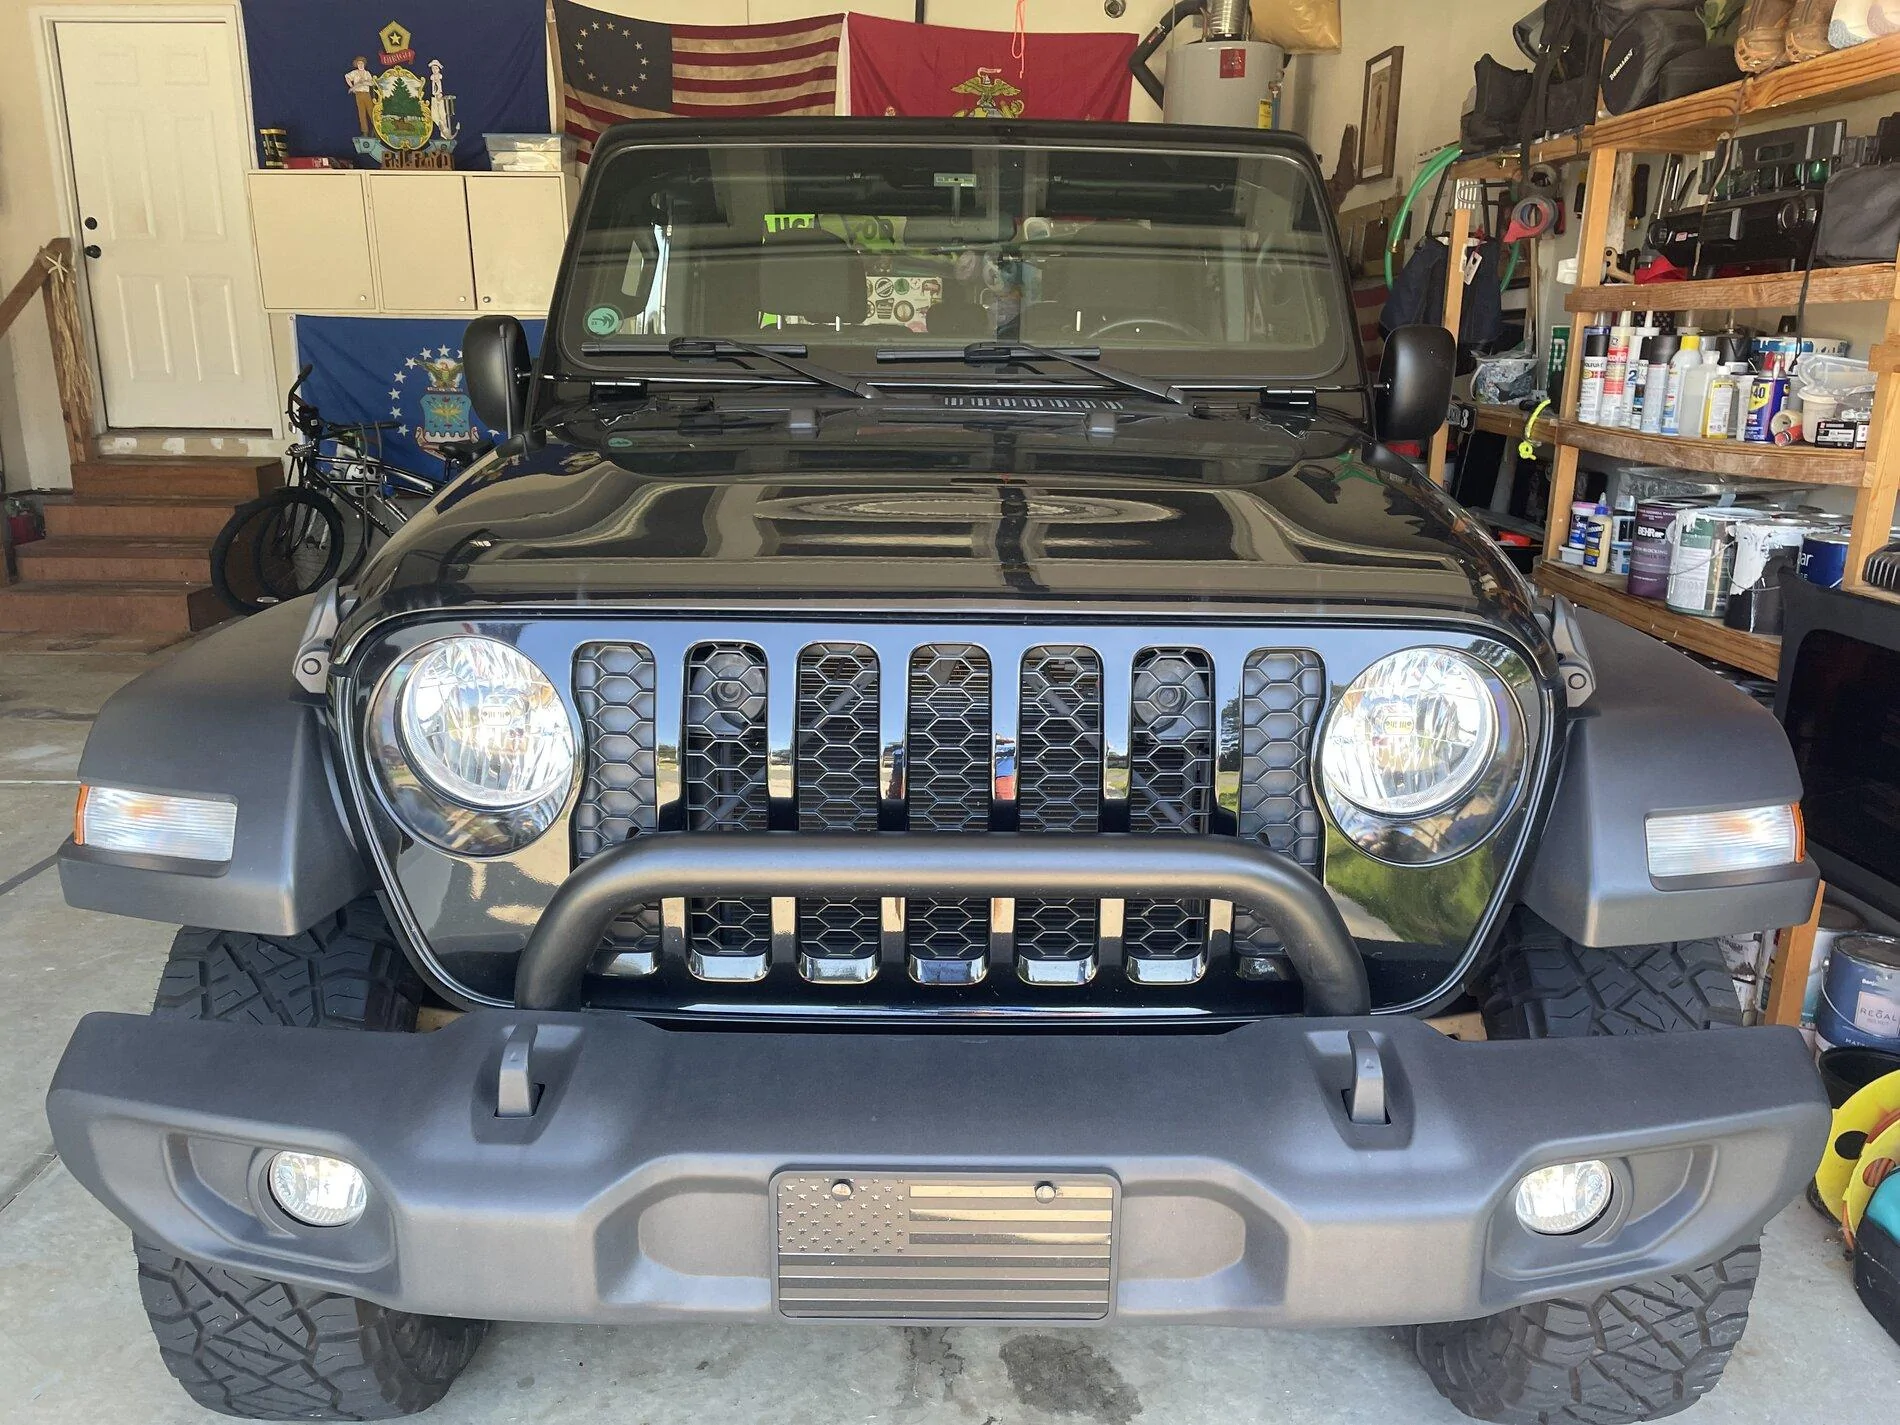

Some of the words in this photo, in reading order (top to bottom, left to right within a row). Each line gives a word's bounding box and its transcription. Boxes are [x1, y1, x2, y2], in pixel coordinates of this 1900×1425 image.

[412, 150, 451, 169] FLOYD
[1637, 525, 1656, 538] BEHR
[1860, 1007, 1898, 1022] REGAL
